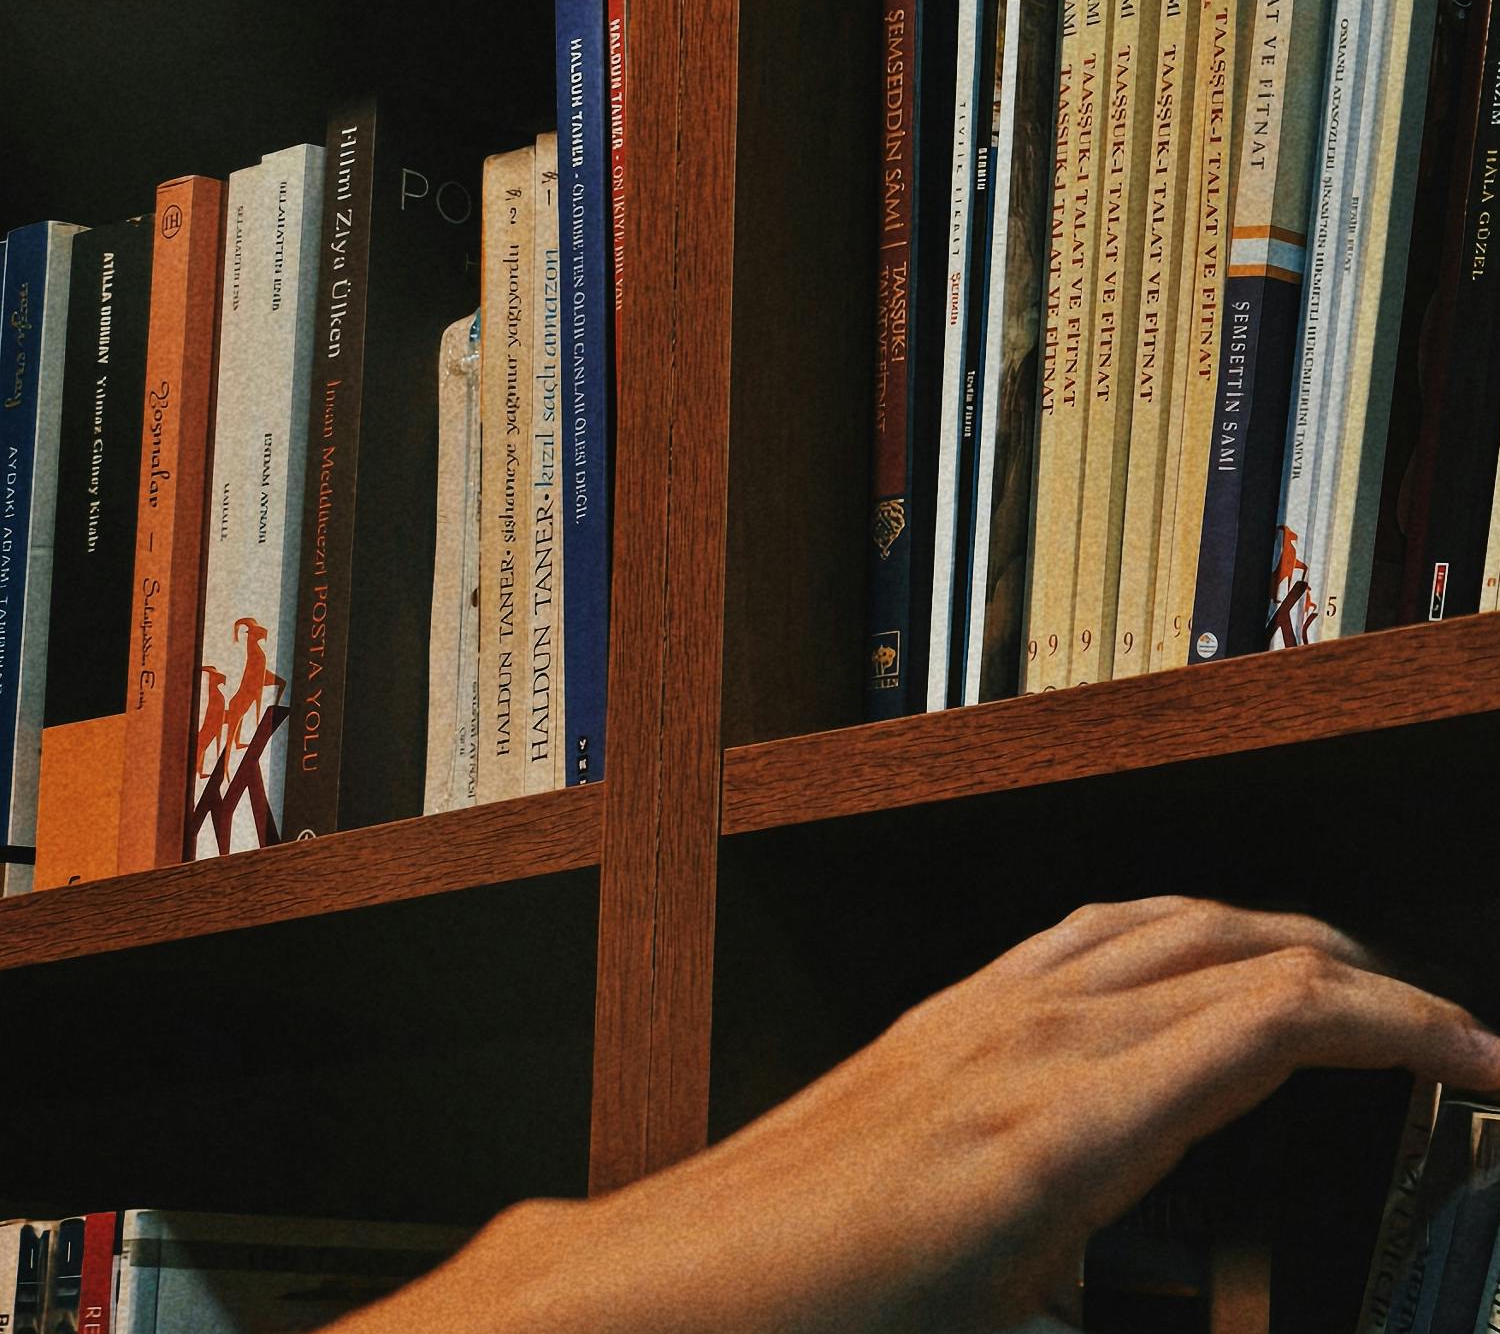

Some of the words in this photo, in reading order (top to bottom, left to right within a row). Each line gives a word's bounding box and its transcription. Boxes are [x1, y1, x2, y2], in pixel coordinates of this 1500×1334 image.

[884, 10, 907, 162] ŞEMSEDDİN
[1261, 36, 1277, 65] VE
[1157, 44, 1176, 176] TAAŞŞUK-I
[1250, 78, 1274, 170] FİTNAT
[330, 209, 352, 271] Ziya
[1152, 183, 1168, 263] TALAT
[327, 280, 353, 359] Ülken
[1148, 271, 1161, 302] VE
[1140, 312, 1157, 403] FİTNAT
[533, 507, 554, 616] TANER
[309, 585, 327, 677] POSTA
[302, 688, 322, 773] YOLU
[530, 627, 553, 763] HALDUN
